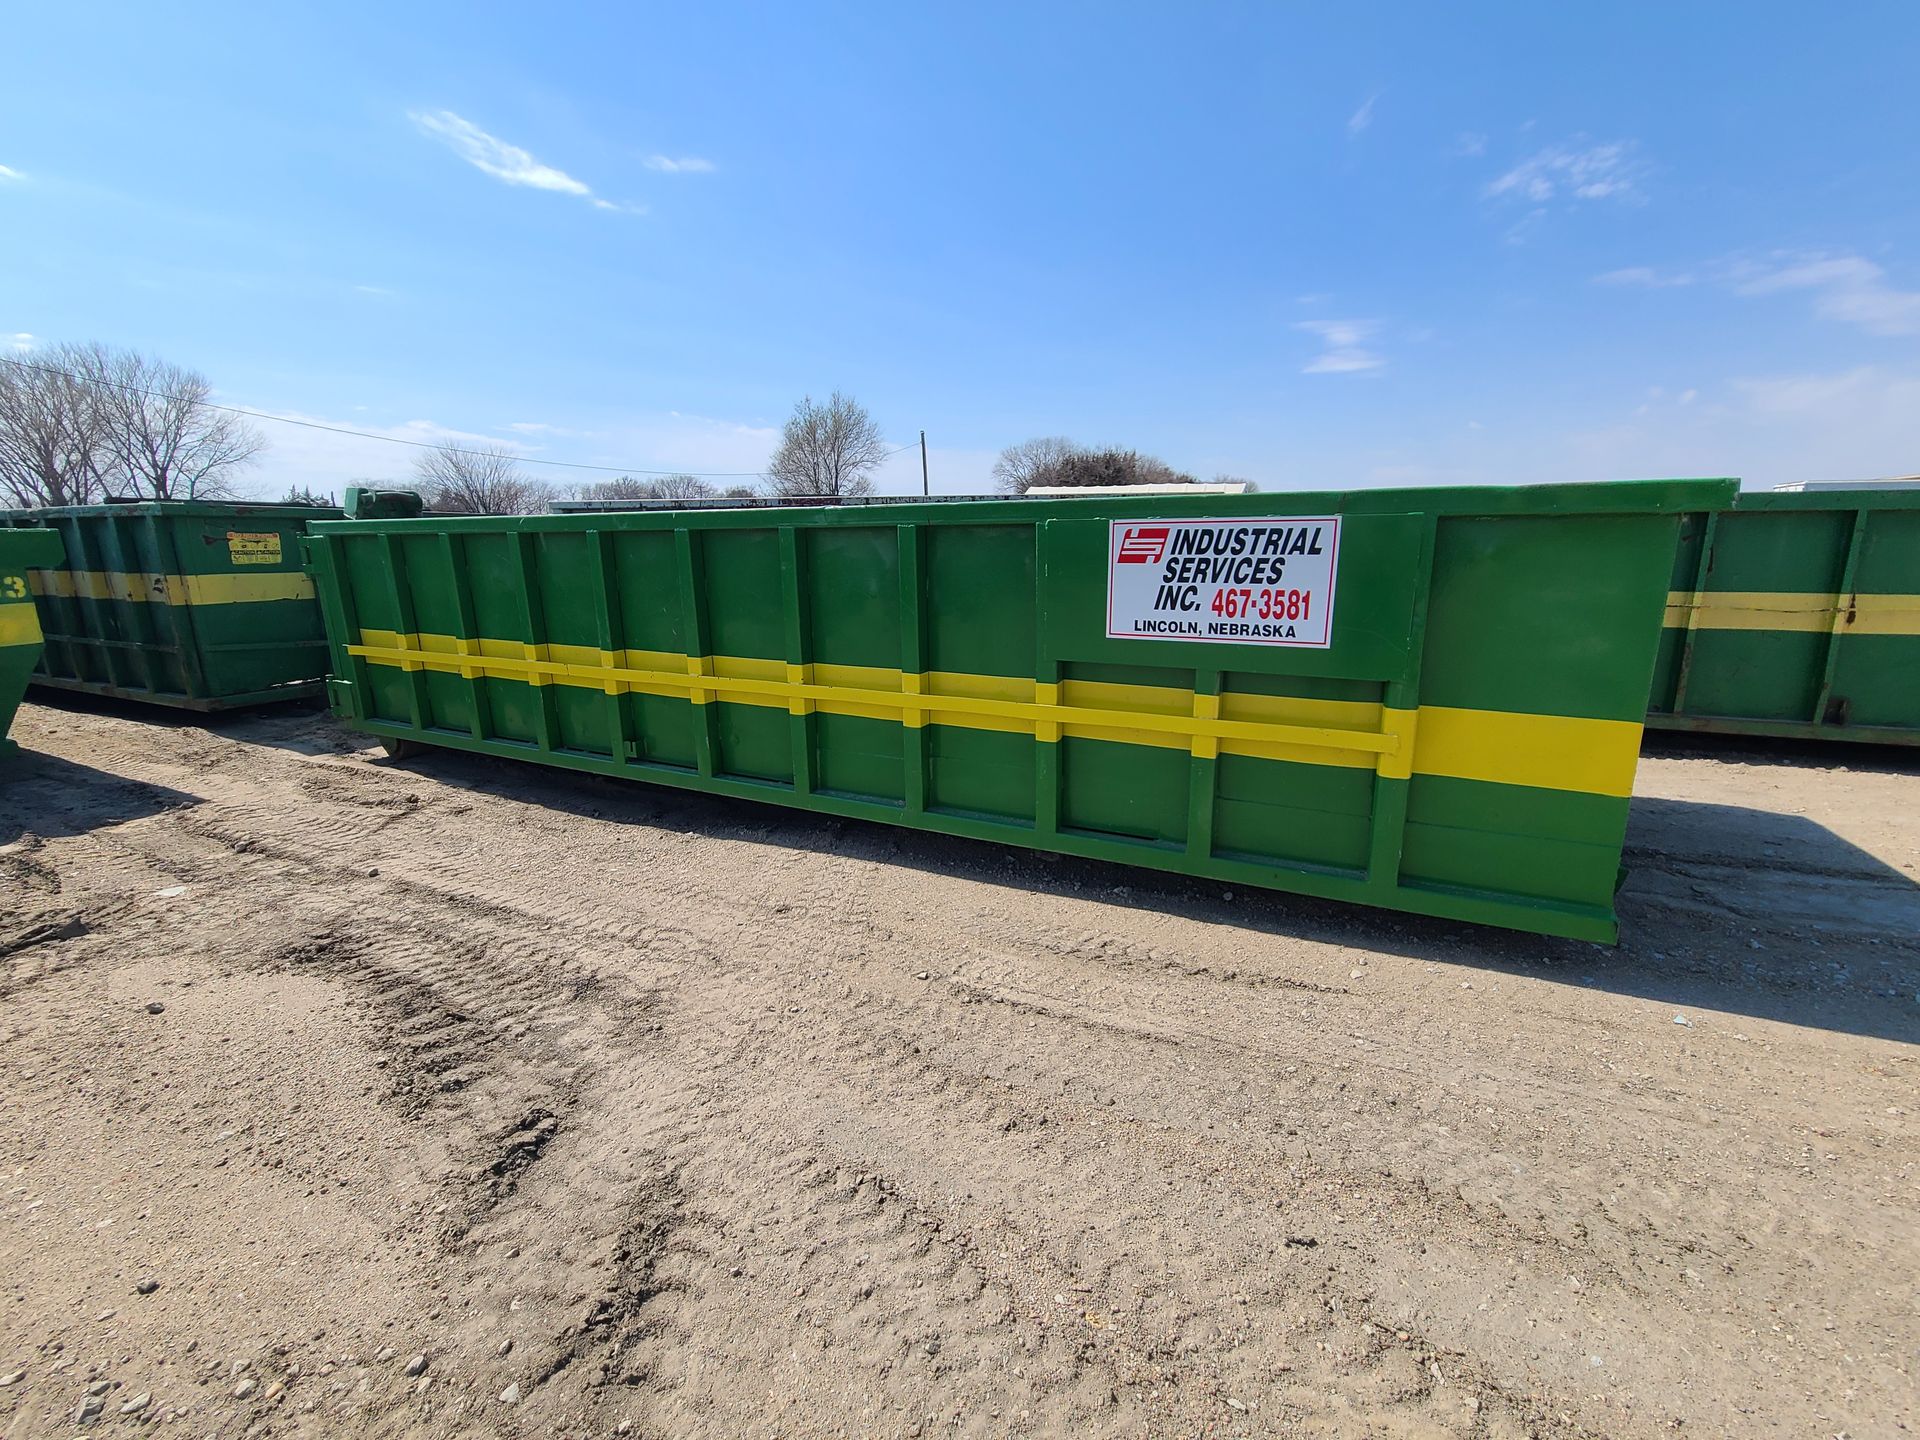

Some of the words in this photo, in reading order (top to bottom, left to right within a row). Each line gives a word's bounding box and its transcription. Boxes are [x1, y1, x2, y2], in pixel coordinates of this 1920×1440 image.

[1170, 527, 1323, 556] INDUSTRIAL
[1163, 557, 1286, 585] SERVICES
[1154, 585, 1201, 612] INC.
[1211, 588, 1312, 620] 467-3581
[1133, 620, 1203, 637] LINCOLN,
[1208, 623, 1297, 638] NEBRASKA
